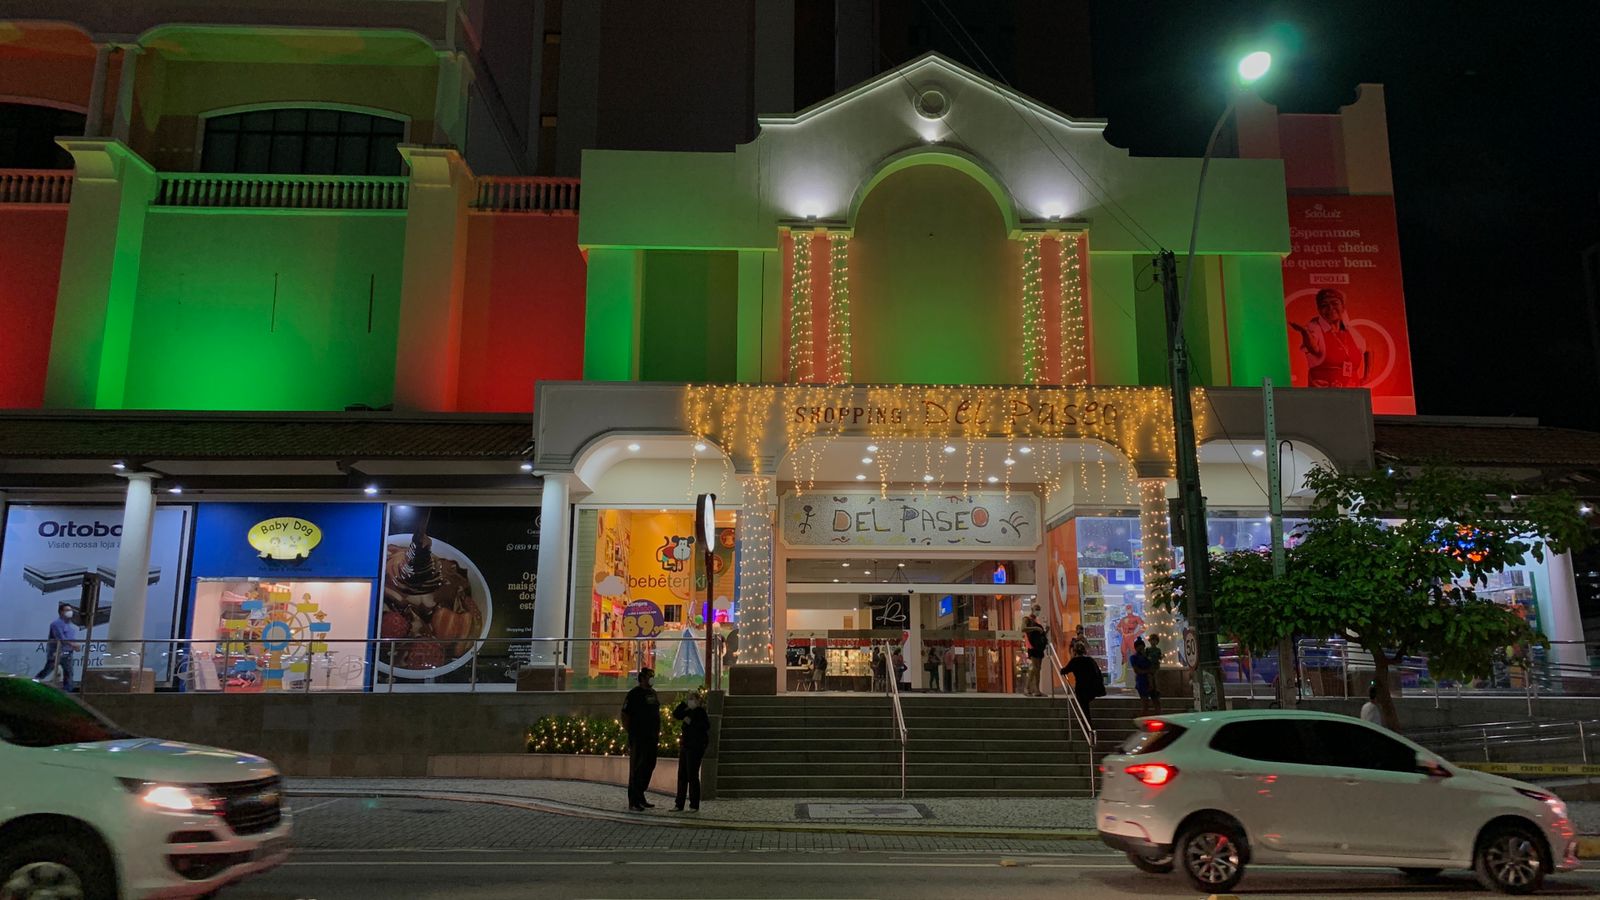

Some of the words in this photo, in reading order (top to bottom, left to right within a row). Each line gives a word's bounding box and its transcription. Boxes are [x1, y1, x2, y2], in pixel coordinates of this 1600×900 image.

[1289, 227, 1360, 240] Esperamos
[1337, 241, 1379, 253] cheios
[1297, 259, 1342, 270] querer
[1343, 257, 1377, 268] bem.
[794, 407, 902, 424] SHOPPING
[832, 508, 891, 532] DEL
[900, 505, 990, 532] PASEO
[260, 521, 289, 535] Baby
[293, 521, 314, 537] Dog
[48, 541, 71, 549] Visite
[100, 541, 115, 550] loja
[508, 581, 528, 590] mais
[519, 592, 530, 600] do
